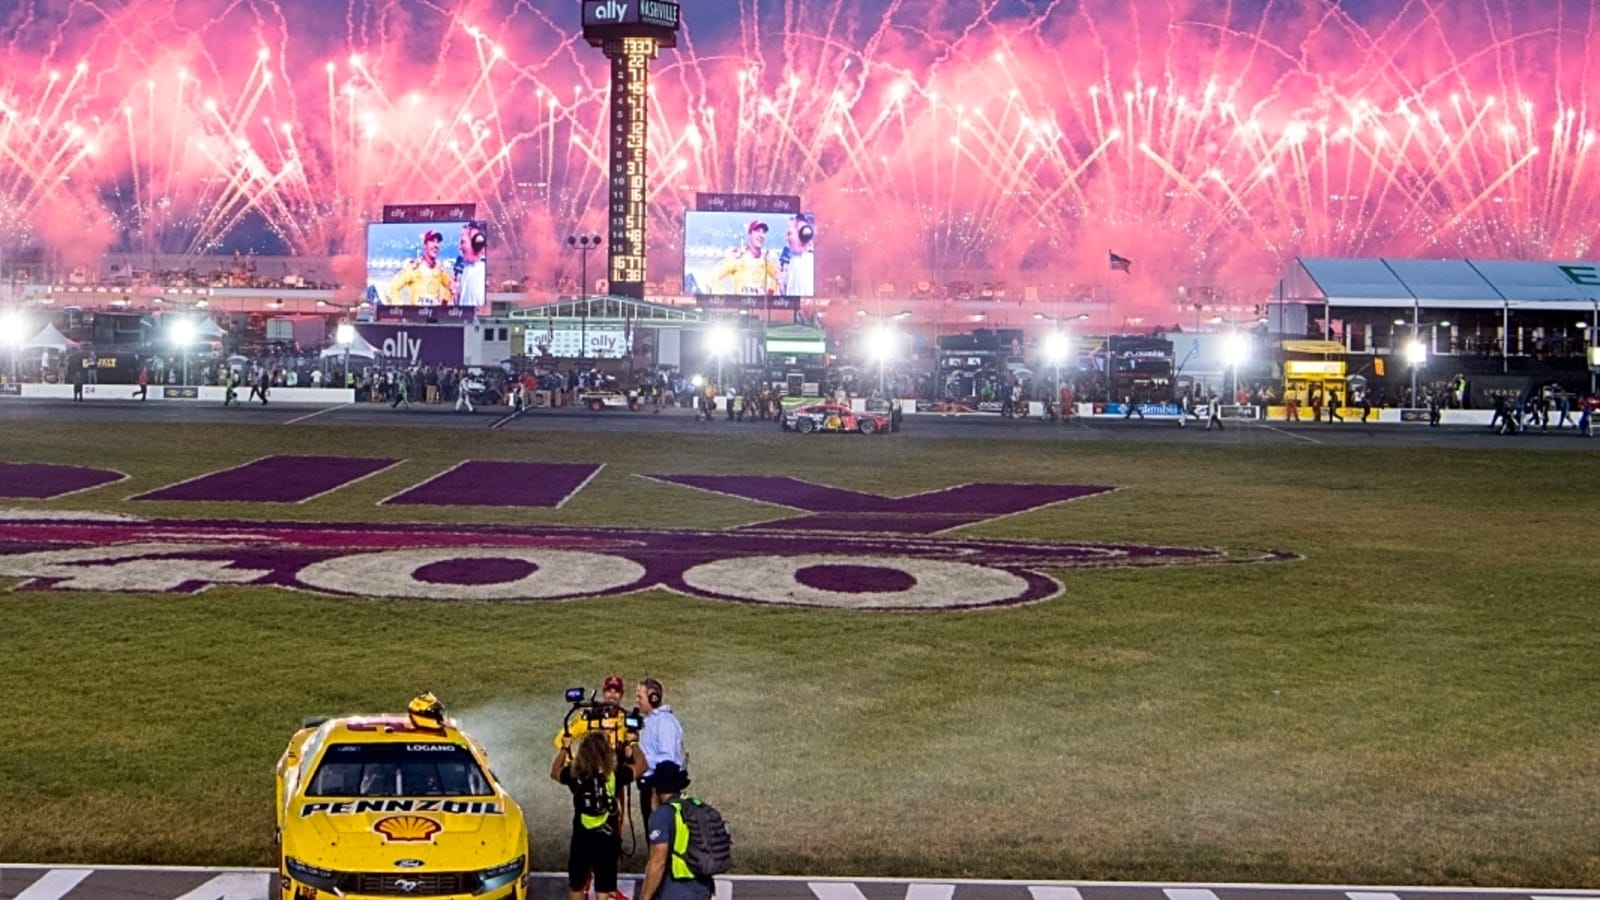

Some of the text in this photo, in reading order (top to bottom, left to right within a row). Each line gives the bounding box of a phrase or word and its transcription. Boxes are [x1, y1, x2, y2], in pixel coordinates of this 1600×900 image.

[596, 1, 628, 22] ally
[641, 1, 678, 21] NASHVILLE
[628, 55, 644, 68] 22
[628, 68, 644, 81] 71
[626, 161, 643, 175] 31
[631, 188, 642, 202] 16
[631, 202, 642, 216] 11
[626, 215, 642, 228] 51
[625, 229, 642, 242] 48
[633, 243, 642, 255] 2
[383, 331, 421, 365] ally
[591, 333, 616, 350] ally
[406, 744, 455, 752] LOGANO
[301, 800, 504, 818] PENNZOIL
